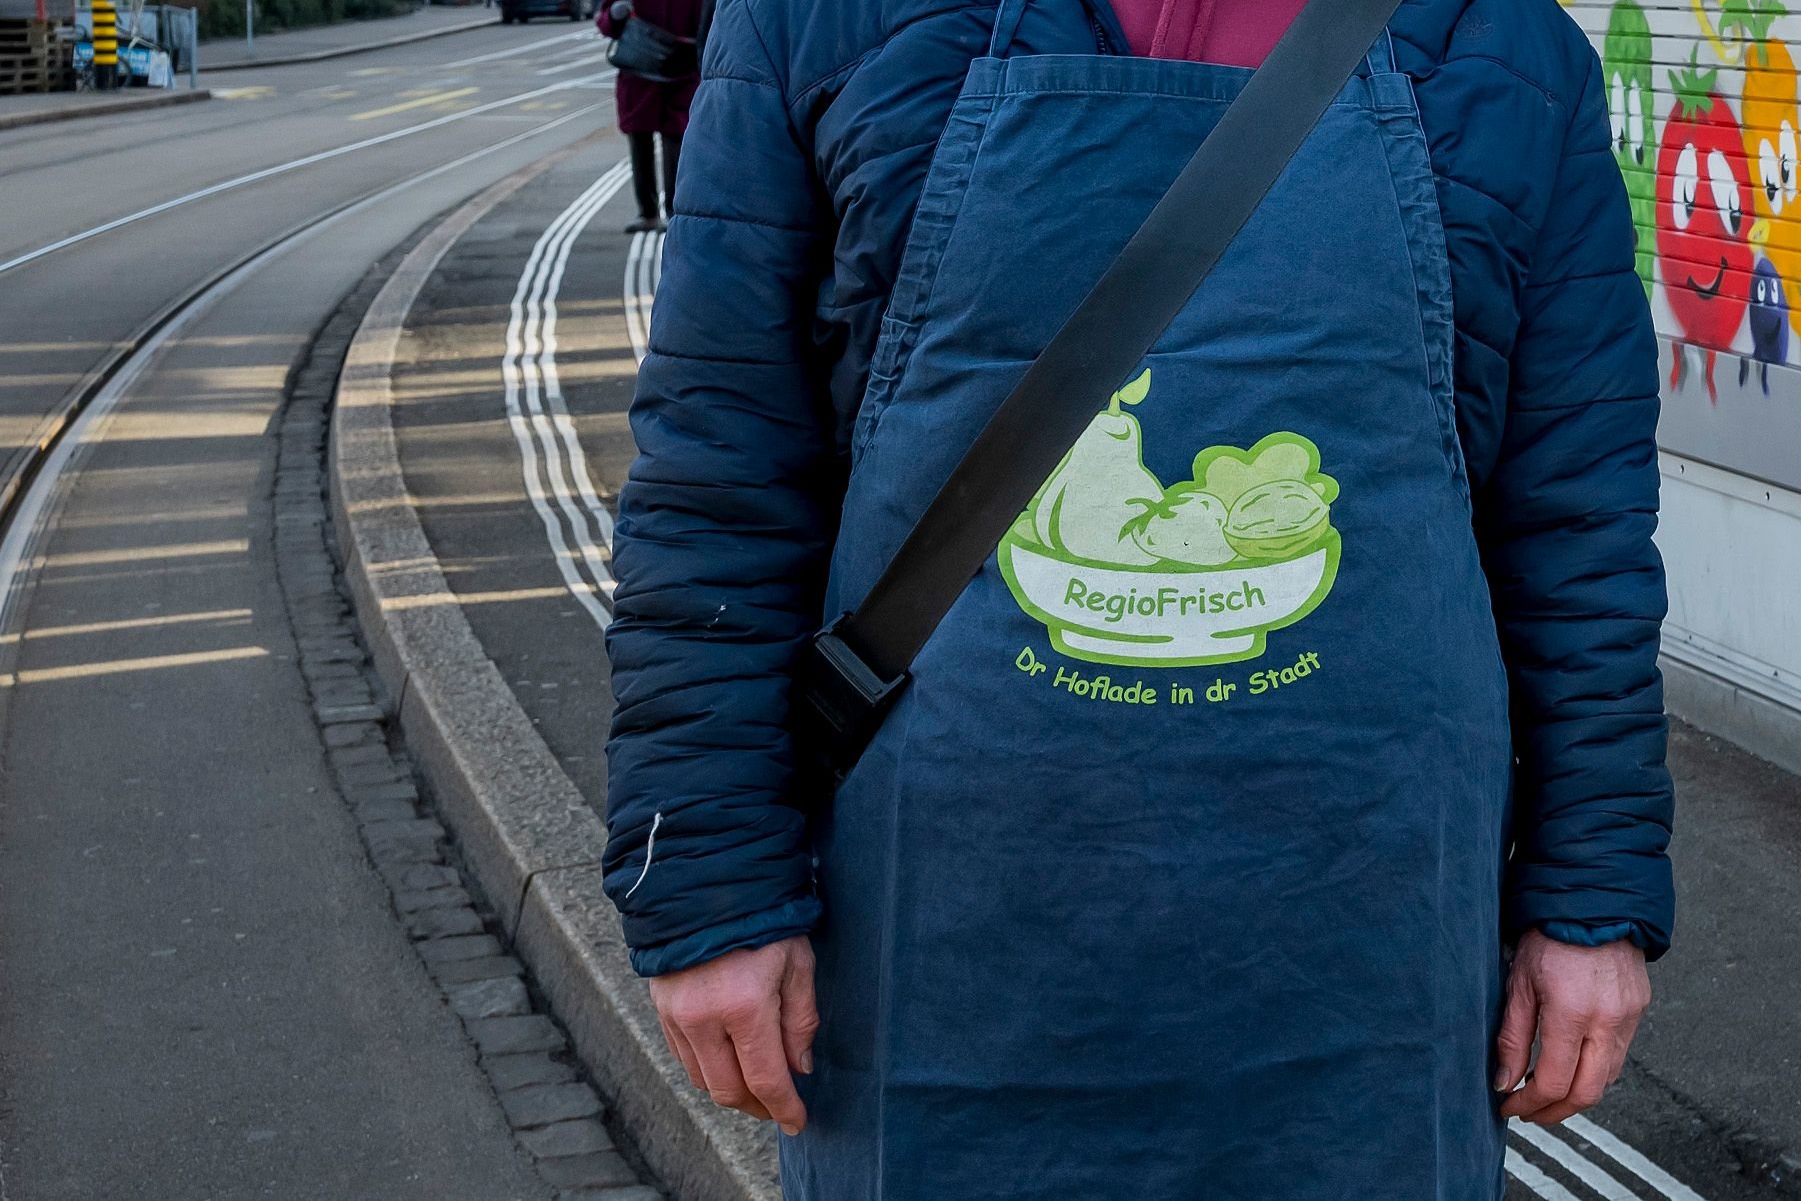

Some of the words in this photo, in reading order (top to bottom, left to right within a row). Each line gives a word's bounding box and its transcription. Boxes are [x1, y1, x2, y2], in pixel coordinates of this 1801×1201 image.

[1064, 578, 1266, 623] RegioFrisch
[1015, 646, 1047, 677] Dr
[1053, 666, 1157, 705] Hoflade
[1171, 682, 1194, 705] in
[1205, 679, 1236, 702] dr
[1249, 651, 1321, 695] Stadt
